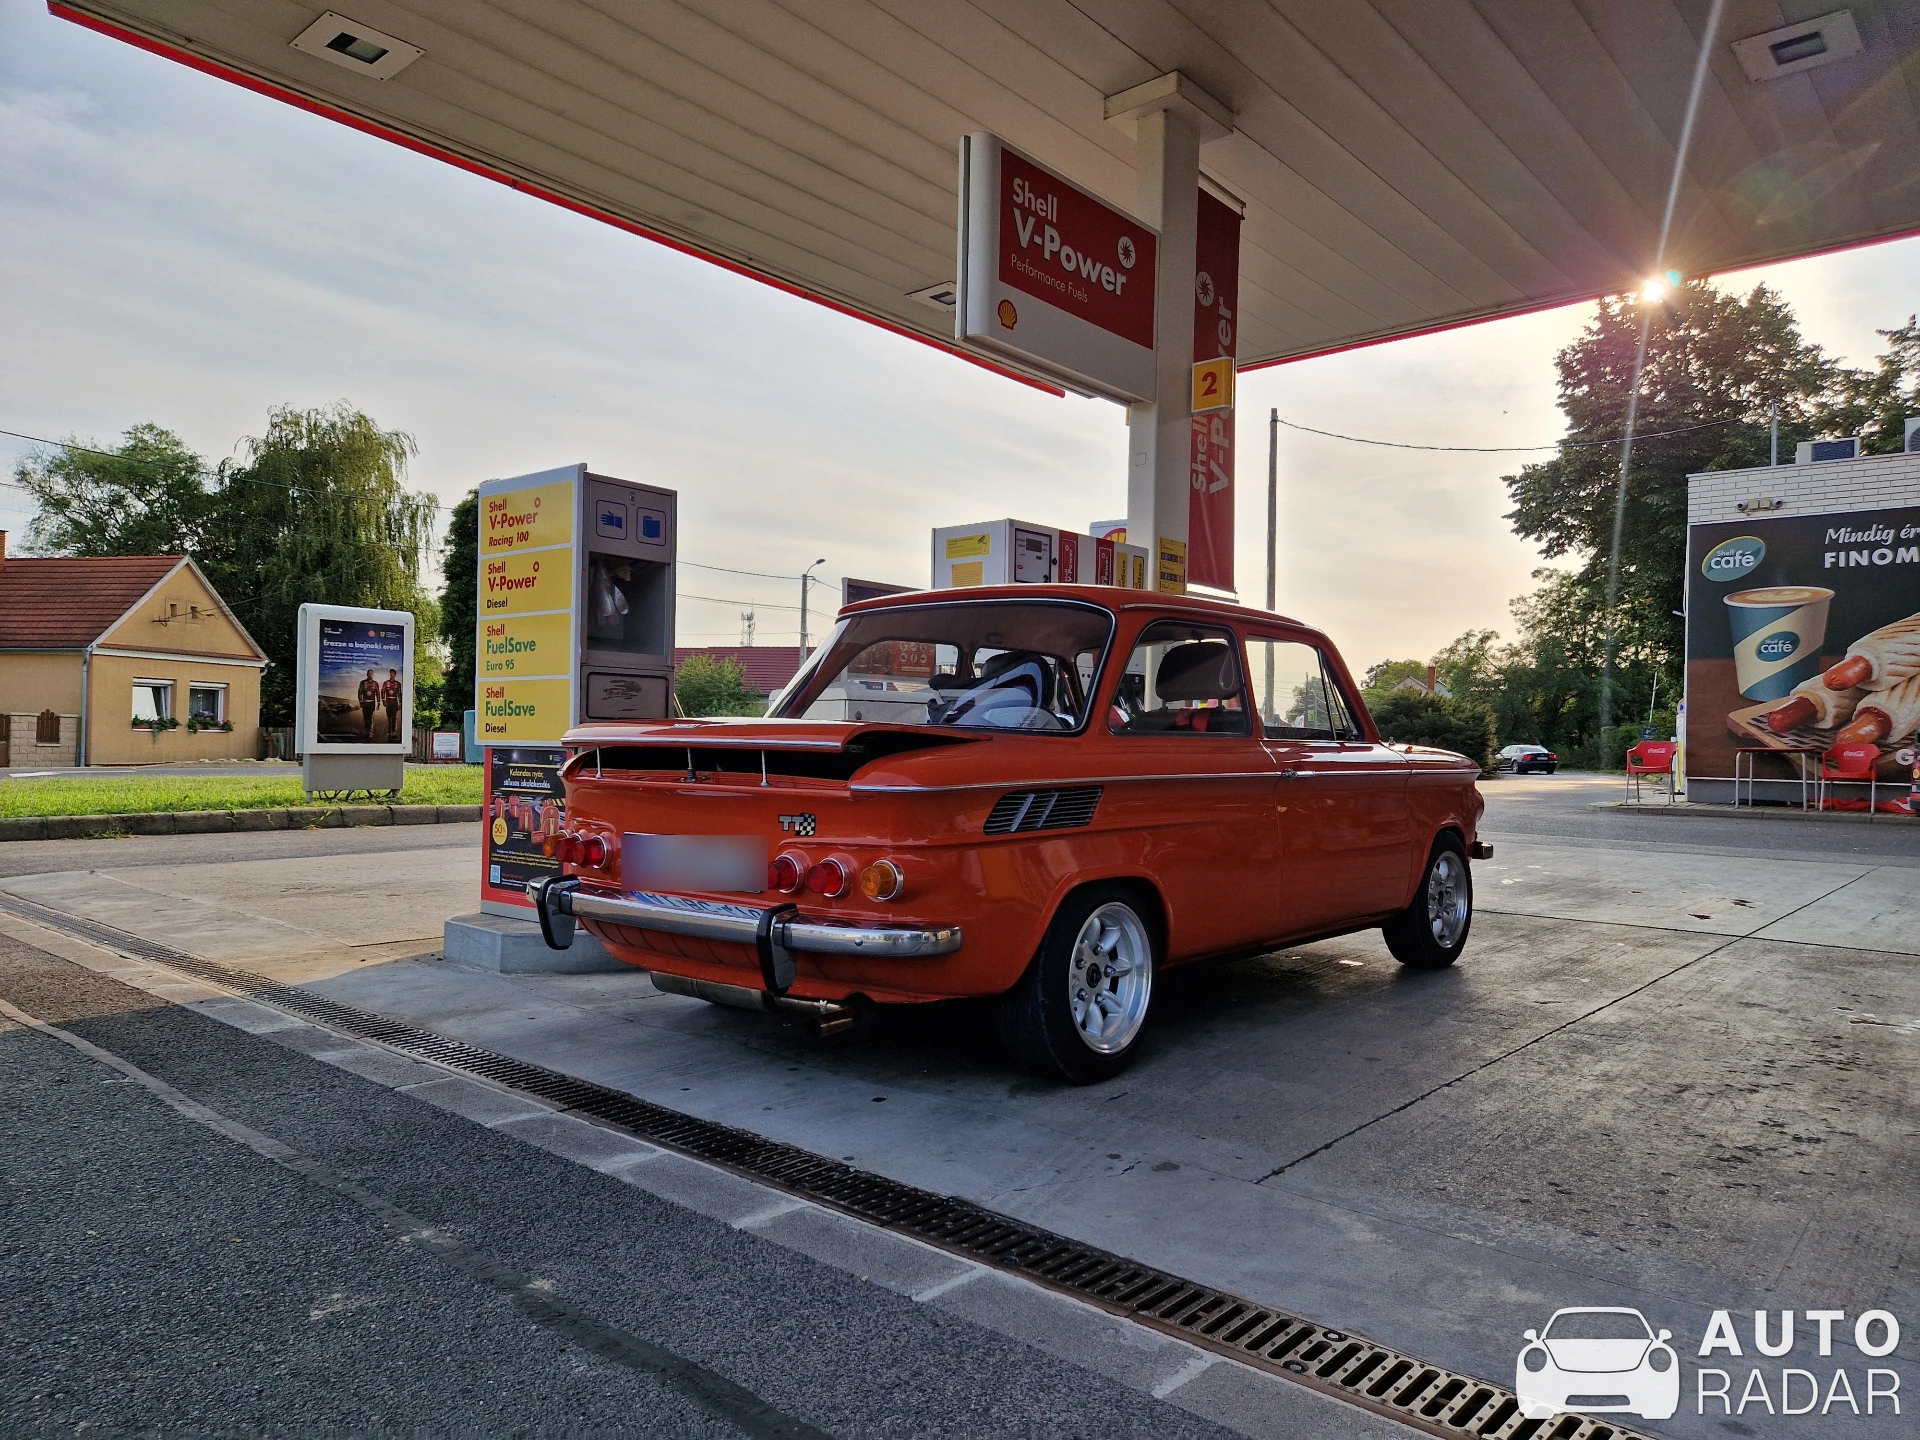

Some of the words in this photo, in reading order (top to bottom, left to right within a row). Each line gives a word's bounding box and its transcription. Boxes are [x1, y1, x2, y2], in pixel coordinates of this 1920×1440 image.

[1013, 177, 1058, 223] Shell
[1013, 207, 1127, 295] V-Power
[1011, 253, 1066, 293] Performance
[1067, 282, 1088, 303] Fuels
[1201, 371, 1218, 397] 2
[1191, 415, 1208, 492] Shell
[488, 498, 507, 513] Shell
[489, 512, 538, 530] V-Power
[489, 535, 513, 547] Racing
[516, 530, 529, 543] 100
[1824, 523, 1895, 545] Mindig
[1710, 550, 1755, 569] café
[1716, 548, 1735, 557] Shell
[488, 561, 506, 574] Shell
[488, 575, 537, 592] V-Power
[486, 597, 508, 609] Diesel
[486, 624, 505, 637] Shell
[354, 641, 382, 650] bajnoki
[486, 637, 536, 655] FuelSave
[1760, 640, 1792, 653] café
[486, 660, 502, 671] Euro
[504, 659, 515, 670] 95
[486, 687, 504, 699] Shell
[485, 700, 535, 717] FuelSave
[485, 722, 507, 733] Diesel
[778, 815, 805, 831] TT
